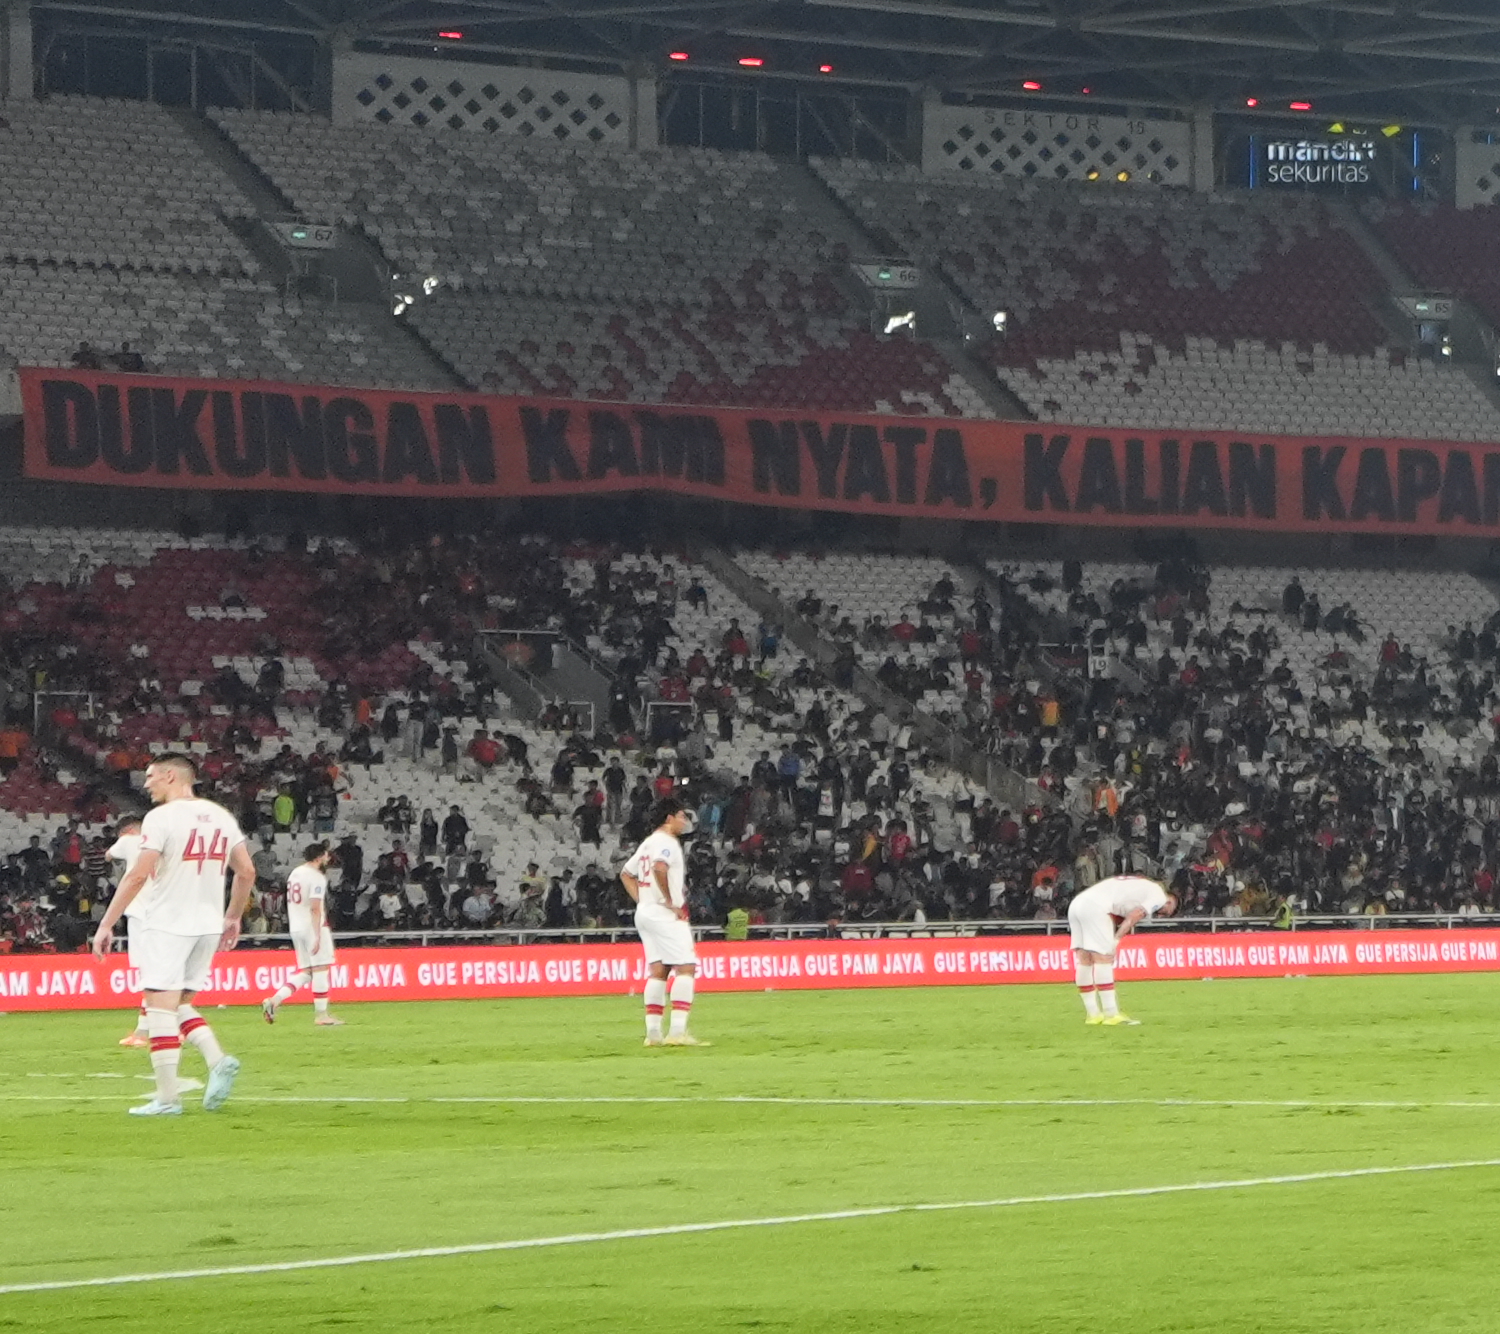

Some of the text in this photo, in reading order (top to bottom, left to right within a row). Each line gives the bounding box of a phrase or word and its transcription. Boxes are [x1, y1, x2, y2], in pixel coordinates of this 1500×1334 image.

[984, 110, 1102, 132] SEKTOR
[1268, 162, 1369, 183] sekuritas
[315, 229, 333, 243] 67
[900, 268, 916, 282] 66
[1435, 300, 1449, 314] 65
[41, 379, 500, 484] DUKUNGAN
[519, 405, 726, 487] KAMI
[749, 418, 997, 512] NYATA,
[1021, 433, 1278, 520] KALIAN
[182, 827, 228, 877] 44
[934, 952, 966, 972] GUE
[970, 951, 1035, 971] PERSIJA
[1038, 950, 1068, 971] GUE
[1156, 944, 1349, 967] GUE PERSIJA GUE PAM JAYA
[1356, 944, 1382, 962] GUE
[1385, 943, 1438, 962] PERSIJA
[1441, 942, 1467, 961] GUE
[1469, 942, 1497, 960] PAM
[354, 964, 405, 987] JAYA
[418, 963, 457, 985] GUE
[462, 961, 539, 984] PERSIJA
[545, 960, 582, 982] GUE
[588, 958, 630, 981] PAM
[696, 953, 924, 979] GUE PERSIJA GUE PAM JAYA
[36, 971, 95, 995] JAYA
